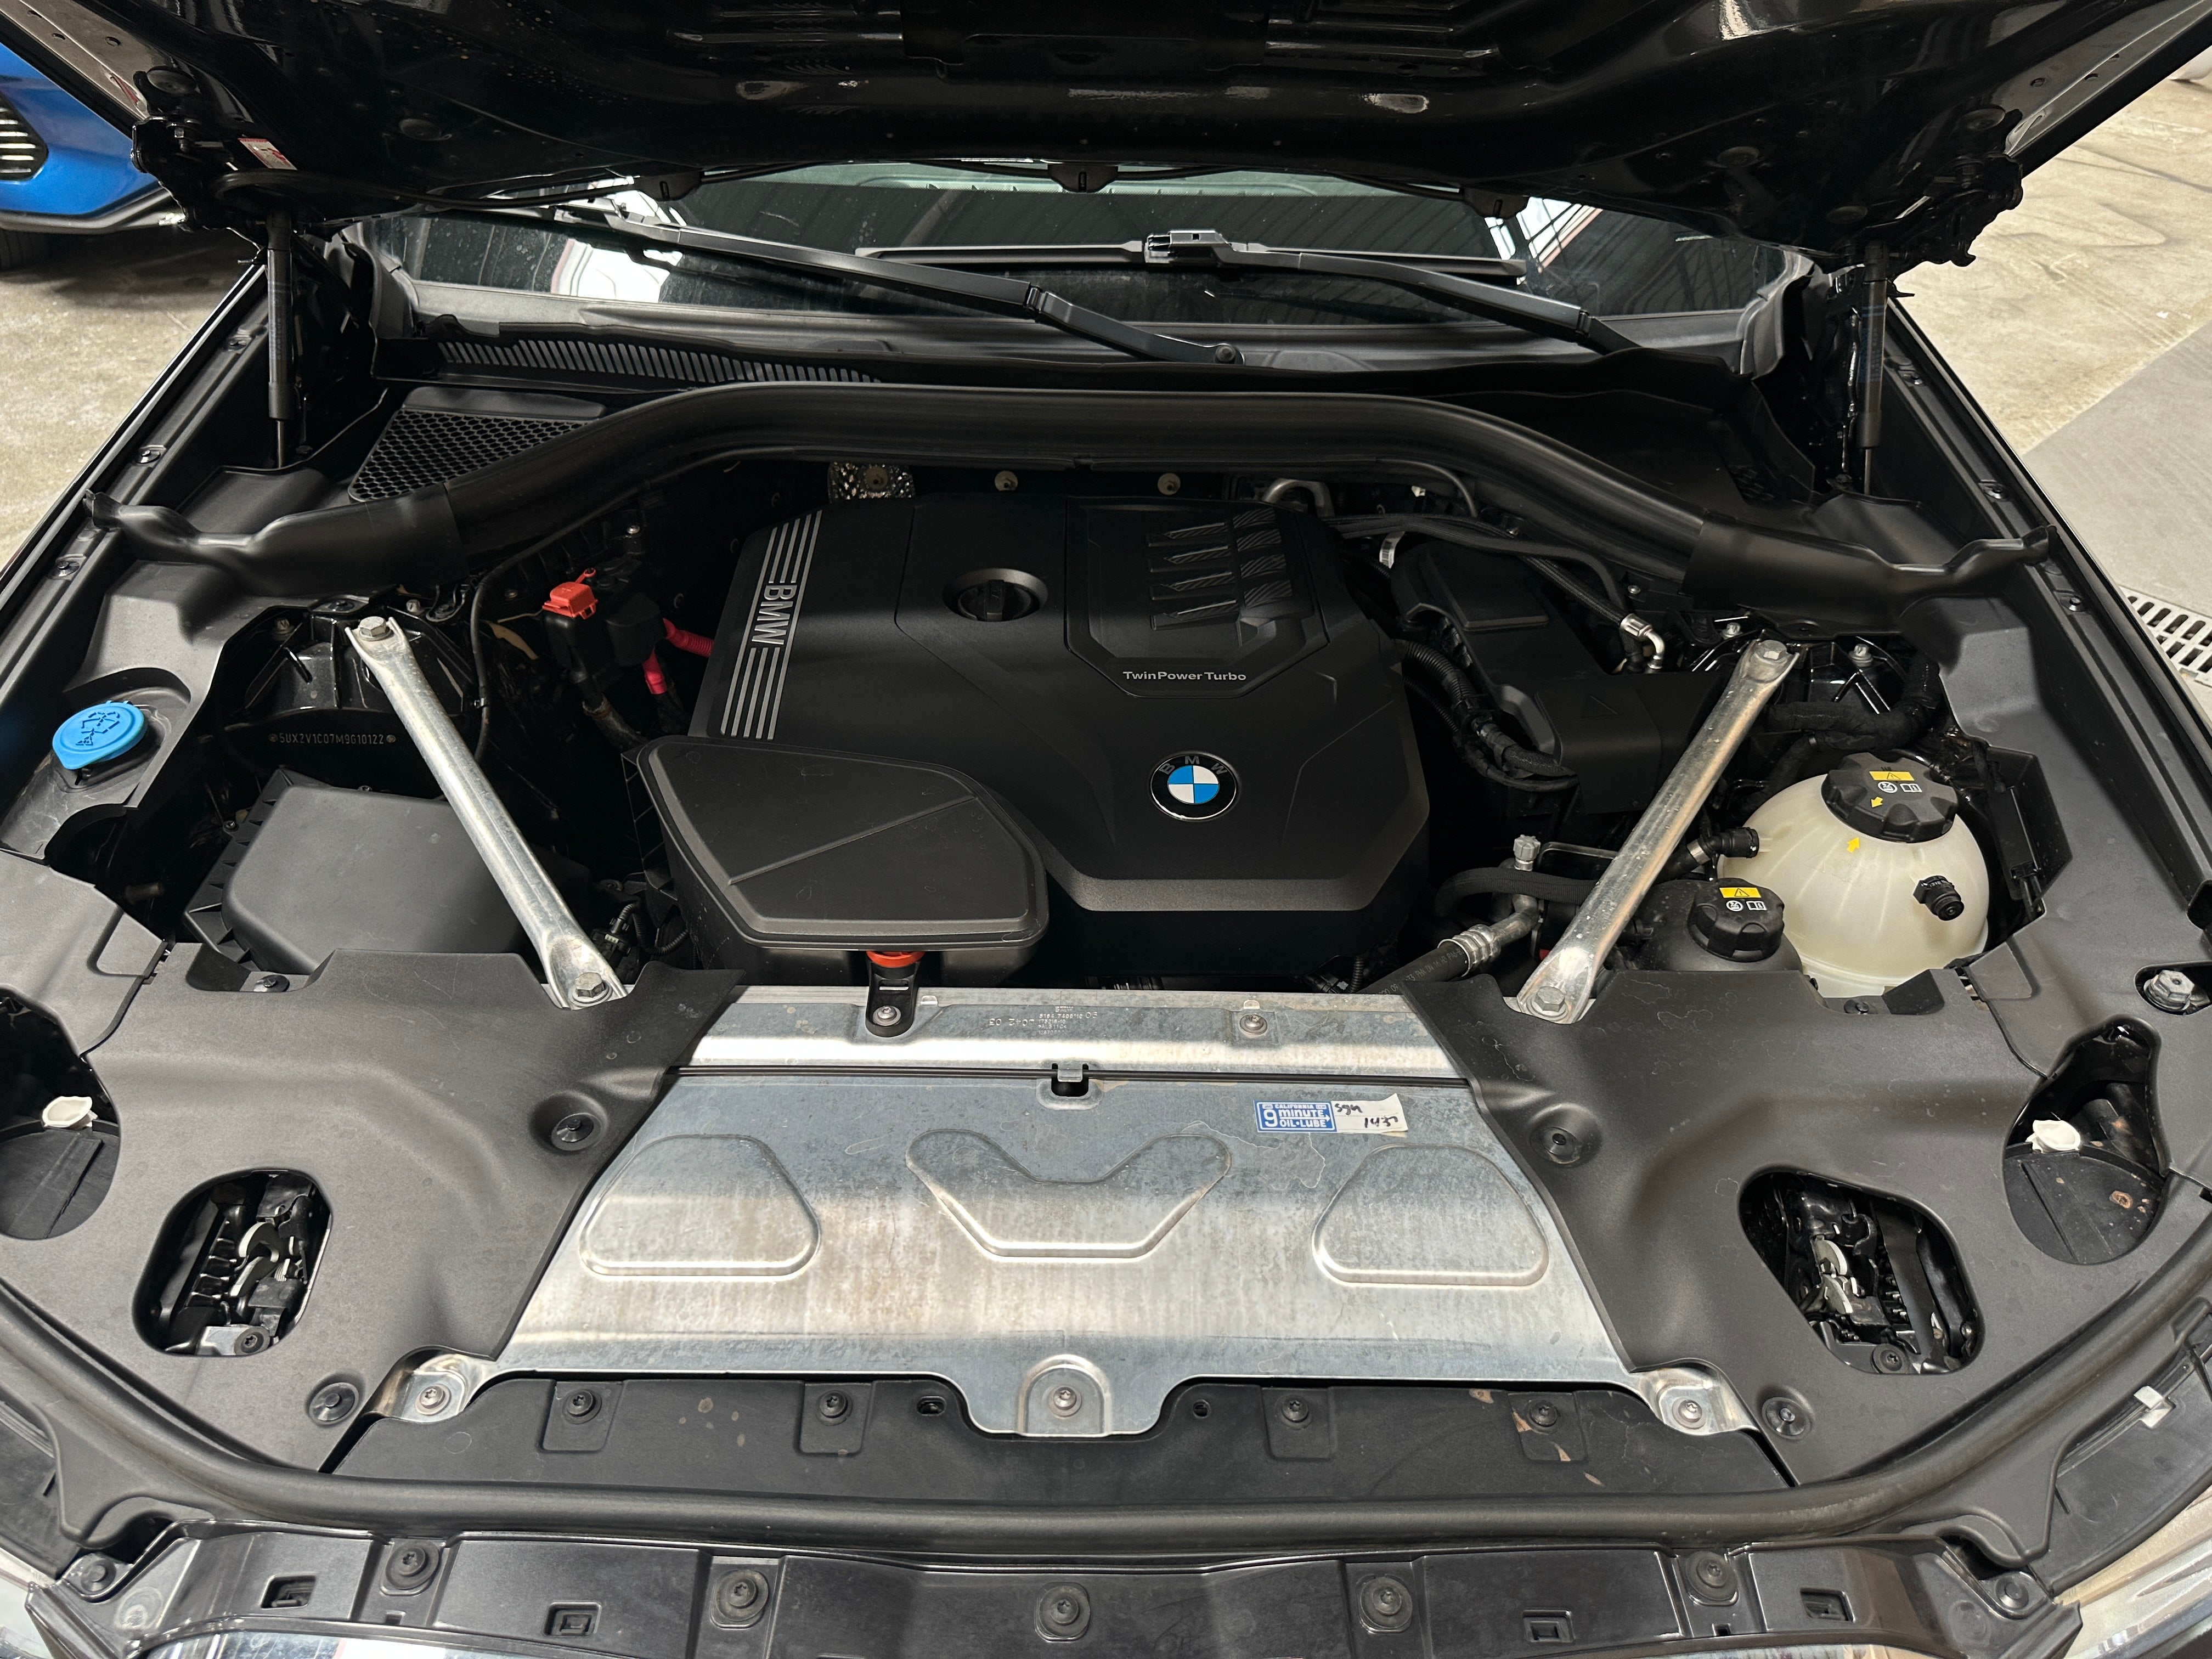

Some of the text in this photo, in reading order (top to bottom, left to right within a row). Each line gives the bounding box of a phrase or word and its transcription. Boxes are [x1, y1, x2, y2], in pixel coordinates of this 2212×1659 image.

[751, 585, 798, 645] BMW
[1122, 671, 1247, 681] TwinPower Turbo
[1158, 755, 1228, 775] BMW
[1263, 1109, 1279, 1127] 9
